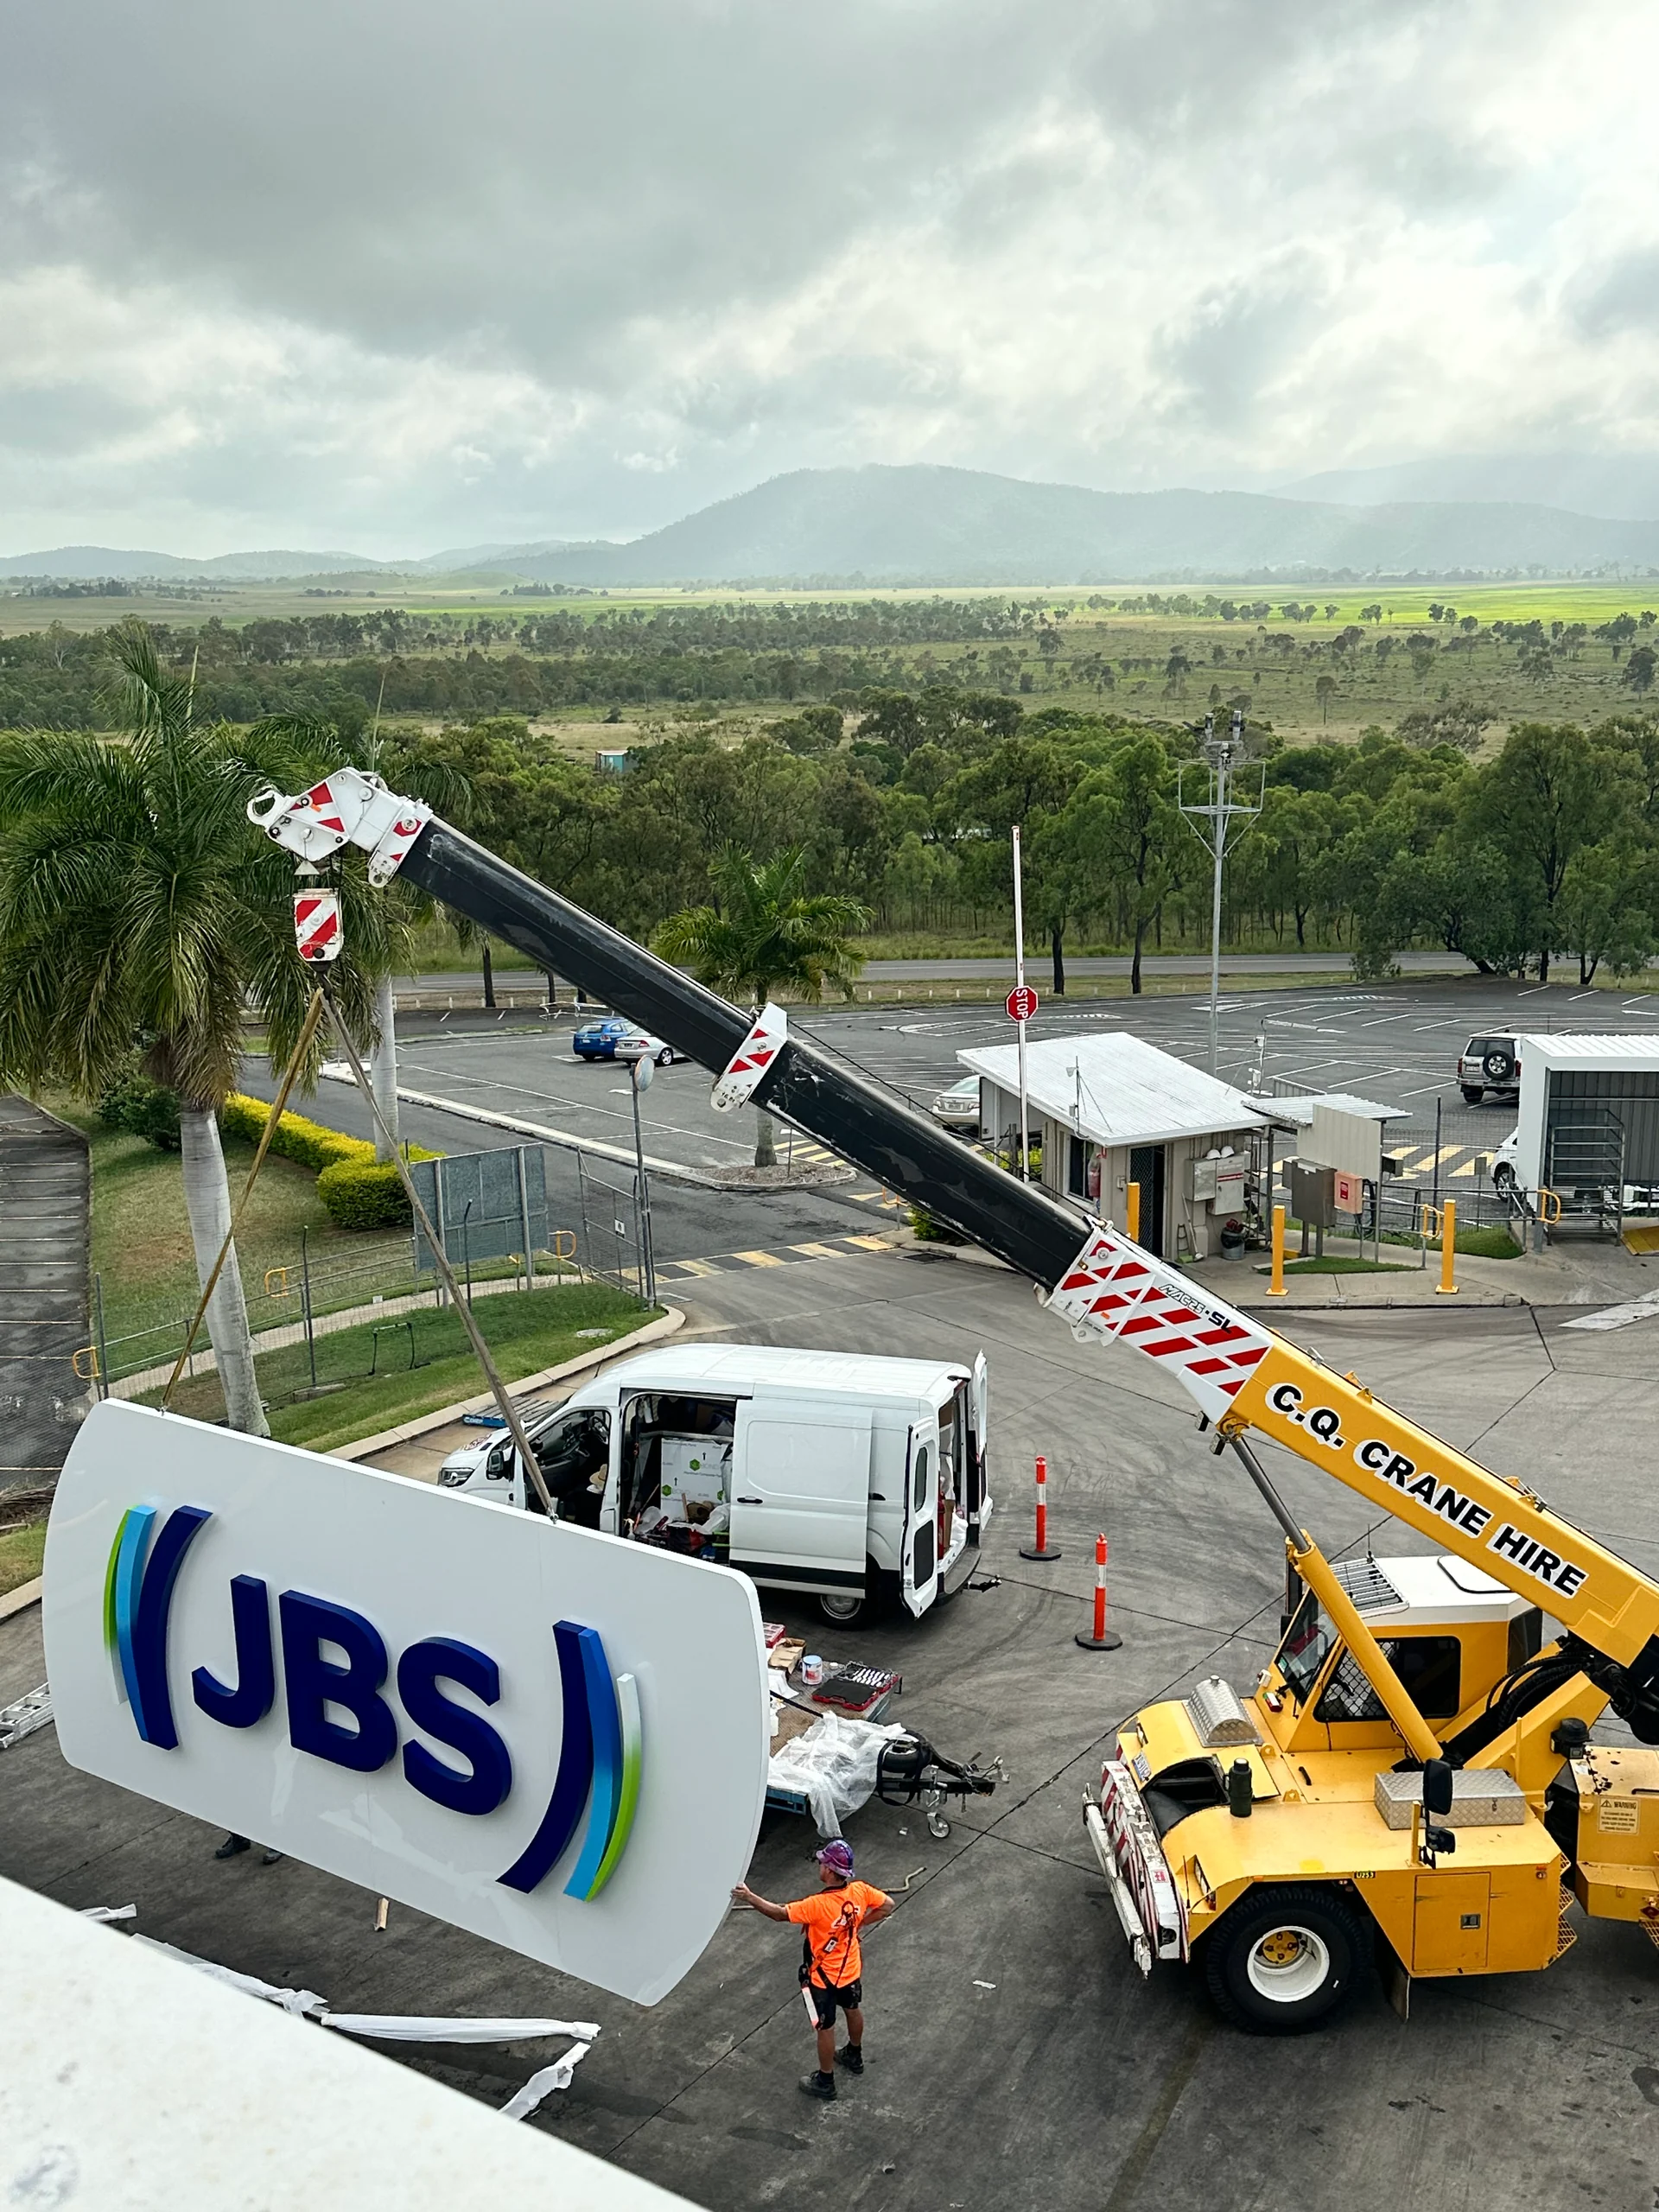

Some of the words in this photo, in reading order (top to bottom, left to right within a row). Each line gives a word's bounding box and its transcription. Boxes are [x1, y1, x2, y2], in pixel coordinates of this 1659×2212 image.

[1016, 989, 1028, 1019] STOP
[1271, 1383, 1344, 1449] C.Q.
[1359, 1440, 1492, 1537] CRANE
[1493, 1524, 1587, 1598] HIRE
[192, 1573, 513, 1817] JBS
